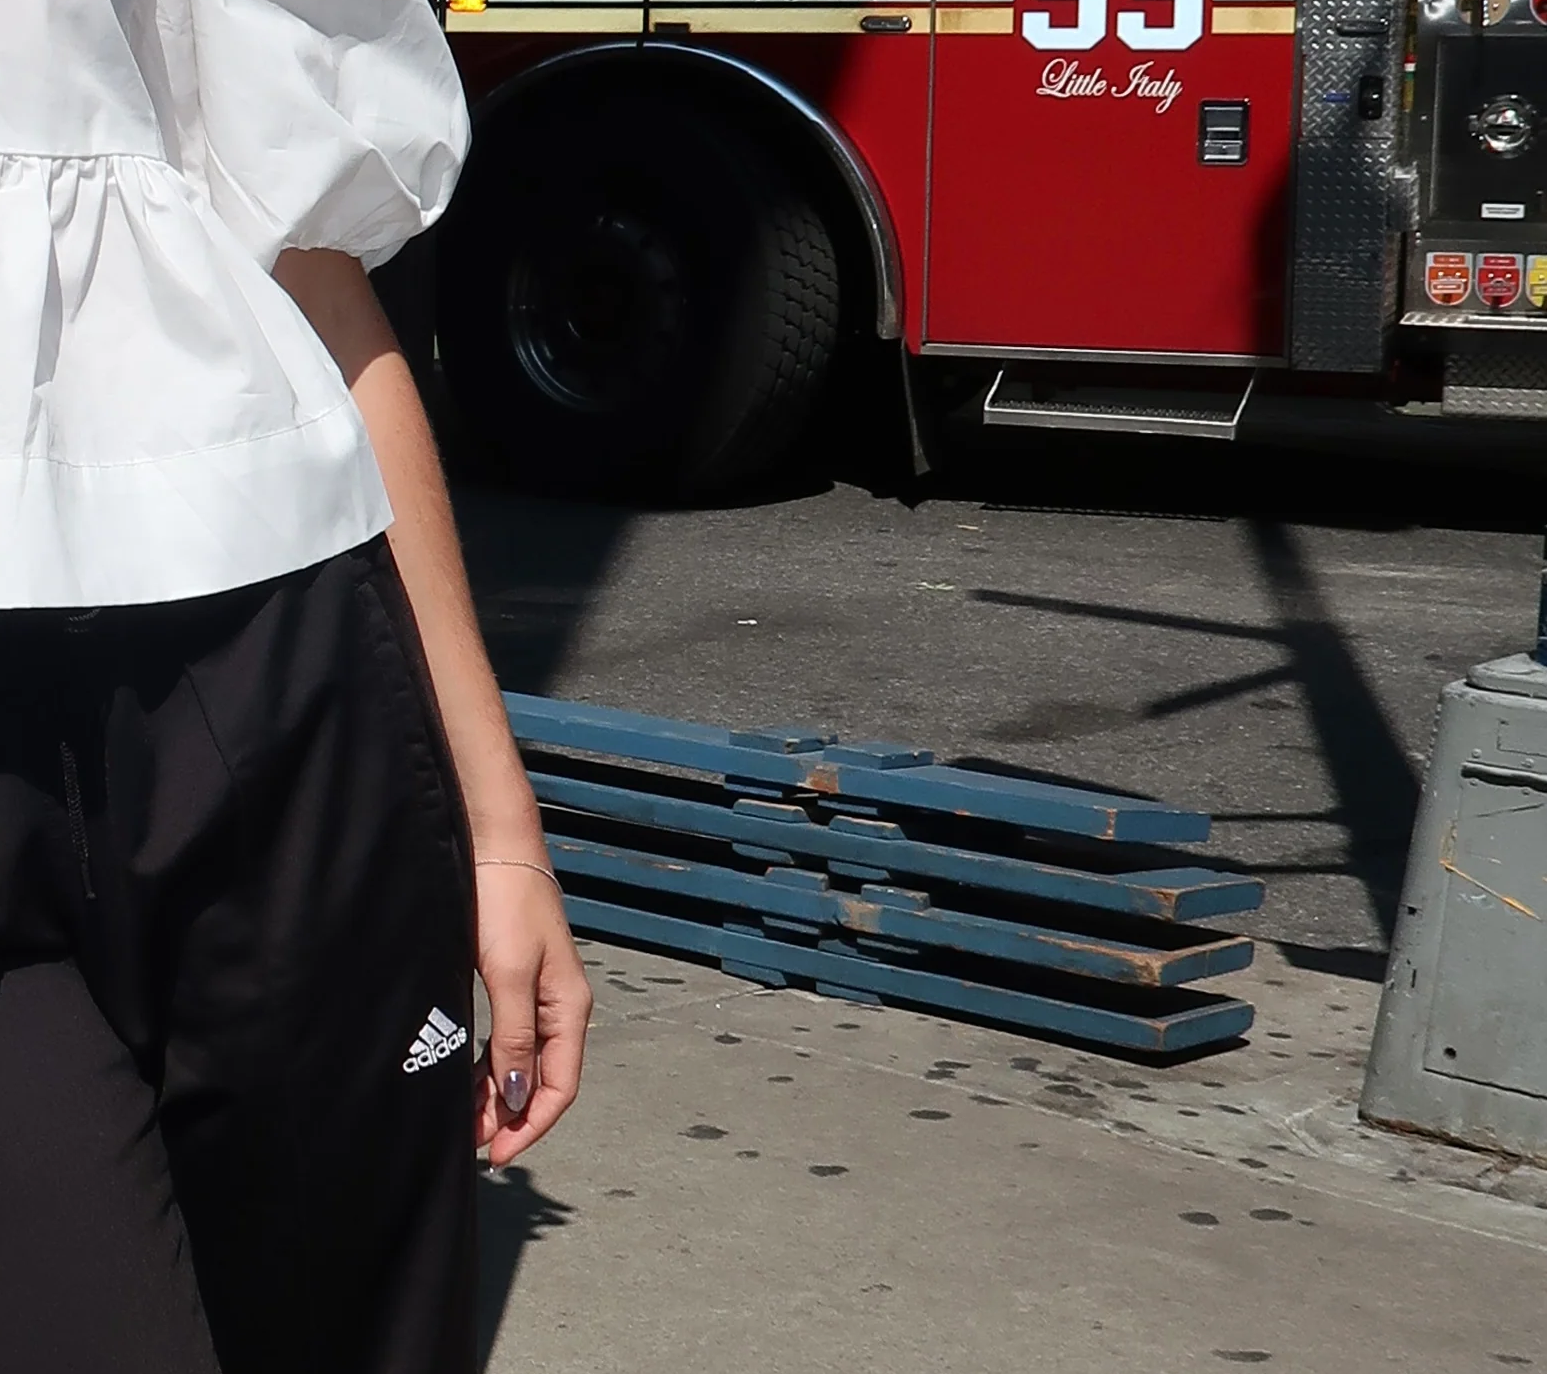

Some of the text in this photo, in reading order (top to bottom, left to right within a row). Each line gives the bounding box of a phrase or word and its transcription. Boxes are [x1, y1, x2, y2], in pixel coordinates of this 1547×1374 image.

[1036, 58, 1184, 114] Little Italy
[402, 1027, 467, 1073] adidas
